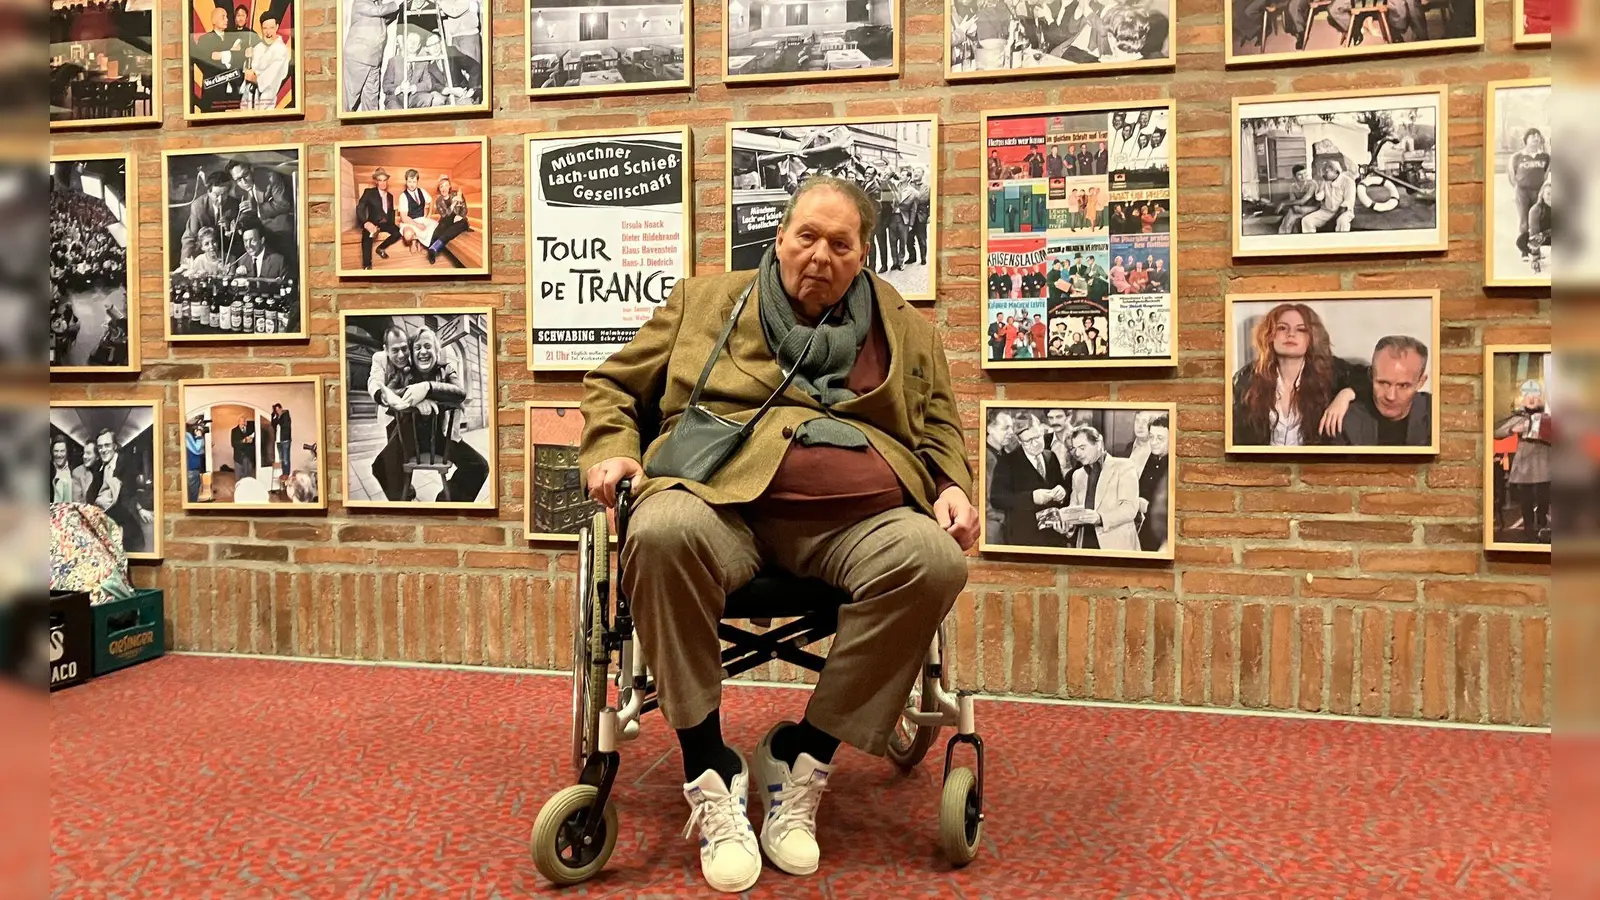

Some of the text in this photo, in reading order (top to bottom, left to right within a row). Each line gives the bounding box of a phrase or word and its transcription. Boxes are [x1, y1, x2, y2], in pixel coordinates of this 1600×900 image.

[551, 147, 631, 171] Münchner
[624, 154, 681, 176] Schieß-
[573, 173, 672, 201] Gesellschaft
[621, 219, 664, 229] Ursula Noack
[621, 232, 680, 242] Dieter Hildebrandt
[536, 236, 612, 262] TOUR
[622, 245, 678, 255] Klaus Havenstein
[647, 257, 674, 266] Diedrich
[541, 267, 676, 304] DE TRANCE
[538, 330, 595, 342] SCHWABING
[546, 350, 569, 361] 21 Uhr
